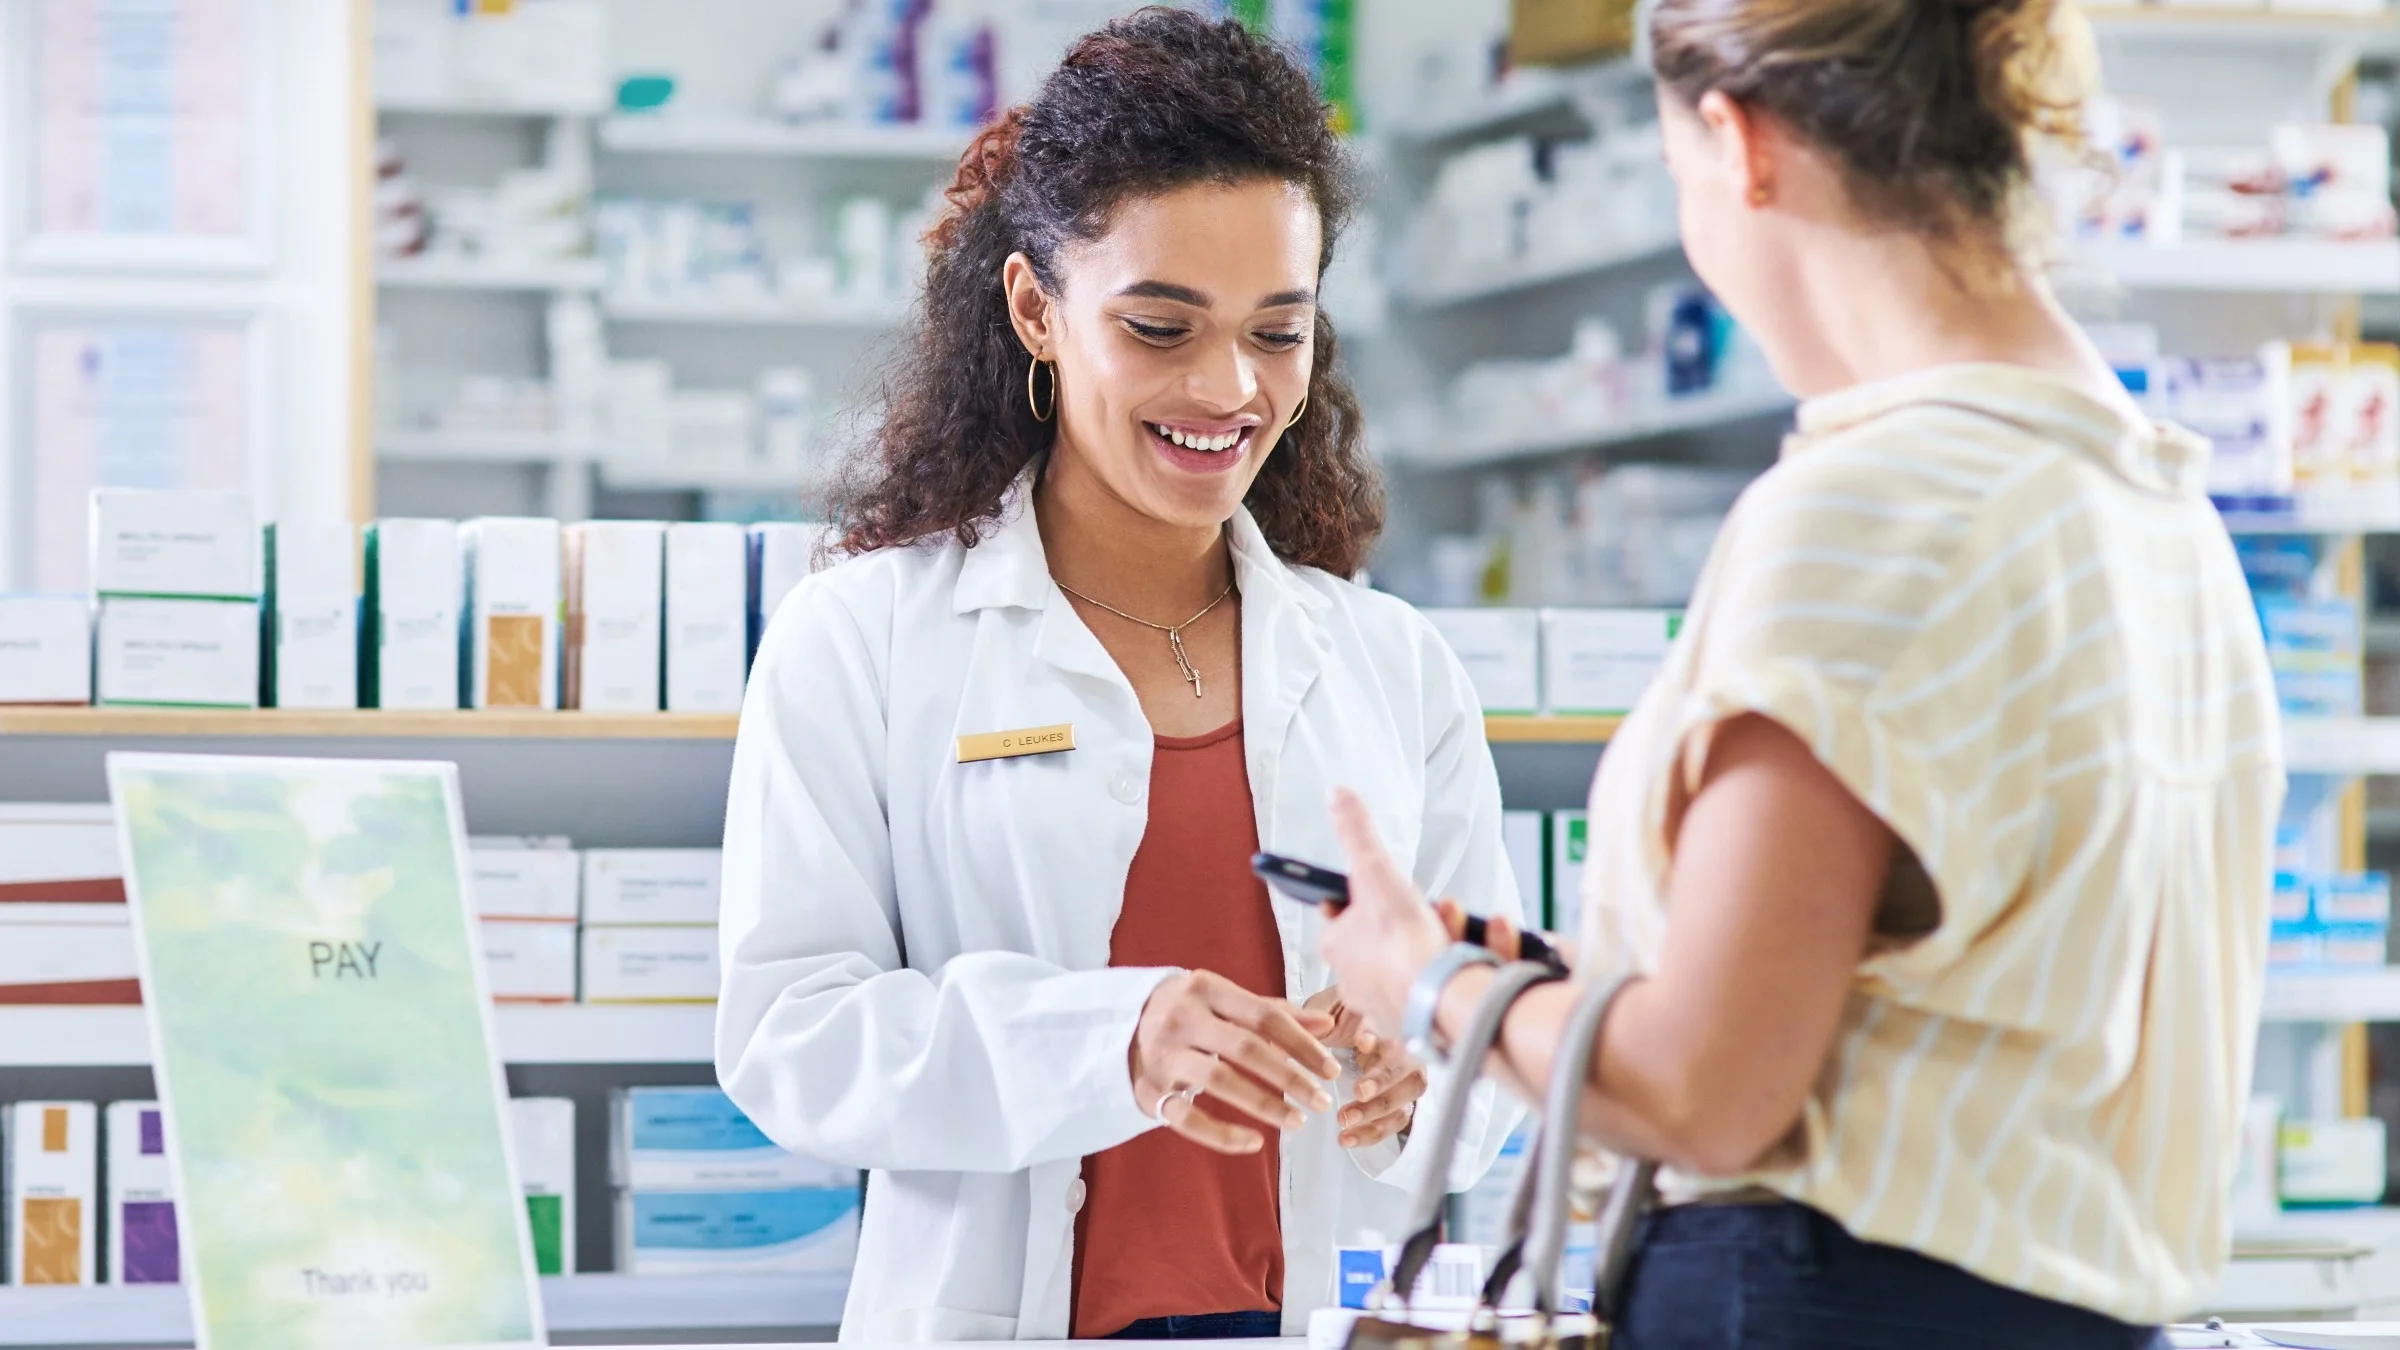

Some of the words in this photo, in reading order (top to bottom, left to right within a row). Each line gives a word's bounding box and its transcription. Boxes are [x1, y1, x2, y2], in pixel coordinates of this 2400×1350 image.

[1003, 739, 1011, 748] C
[1018, 732, 1064, 746] LEUKES
[309, 941, 383, 979] PAY
[300, 1268, 378, 1297] Thank
[384, 1271, 430, 1299] you
